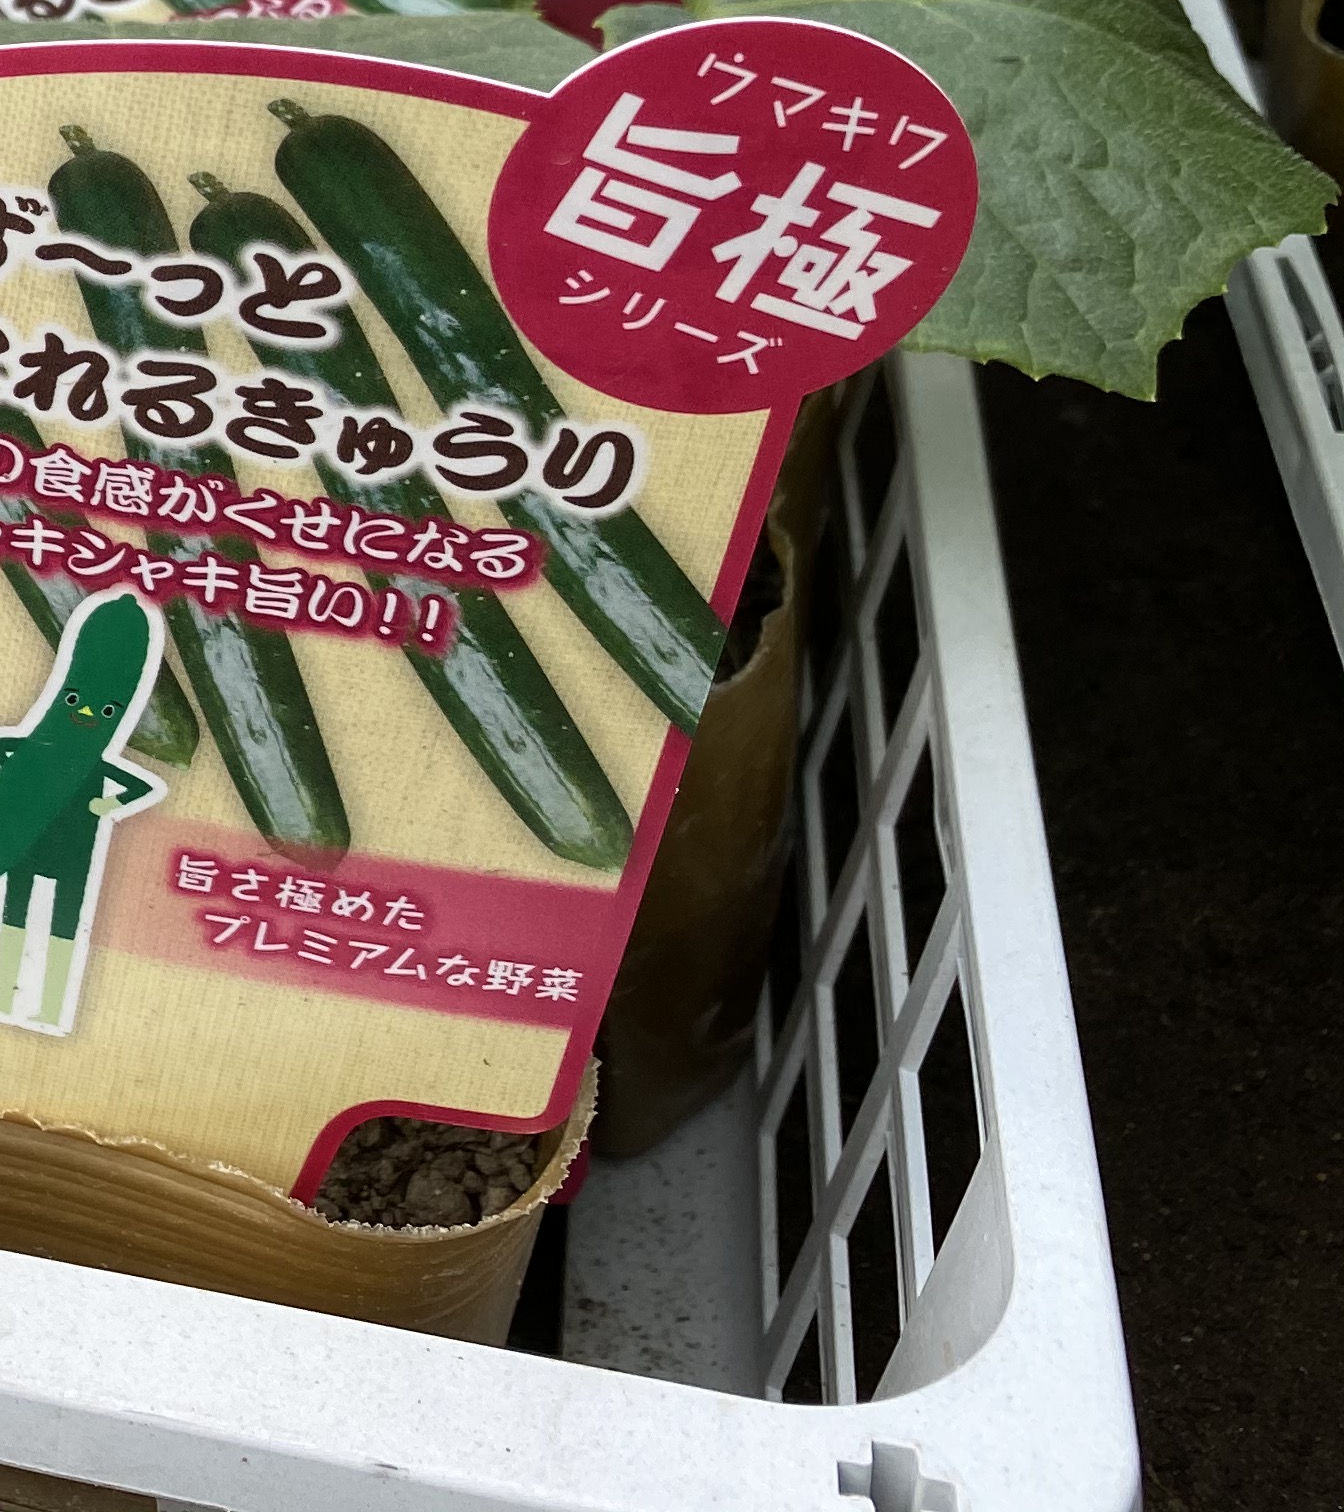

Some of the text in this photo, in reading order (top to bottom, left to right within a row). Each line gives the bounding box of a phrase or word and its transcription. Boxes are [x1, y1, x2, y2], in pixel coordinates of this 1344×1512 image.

[695, 50, 950, 170] ウマキワ
[544, 91, 941, 339] 旨極
[556, 269, 783, 375] シリーズ
[175, 854, 426, 926] 旨さ極めた
[205, 911, 584, 1003] プレミアムな野菜
